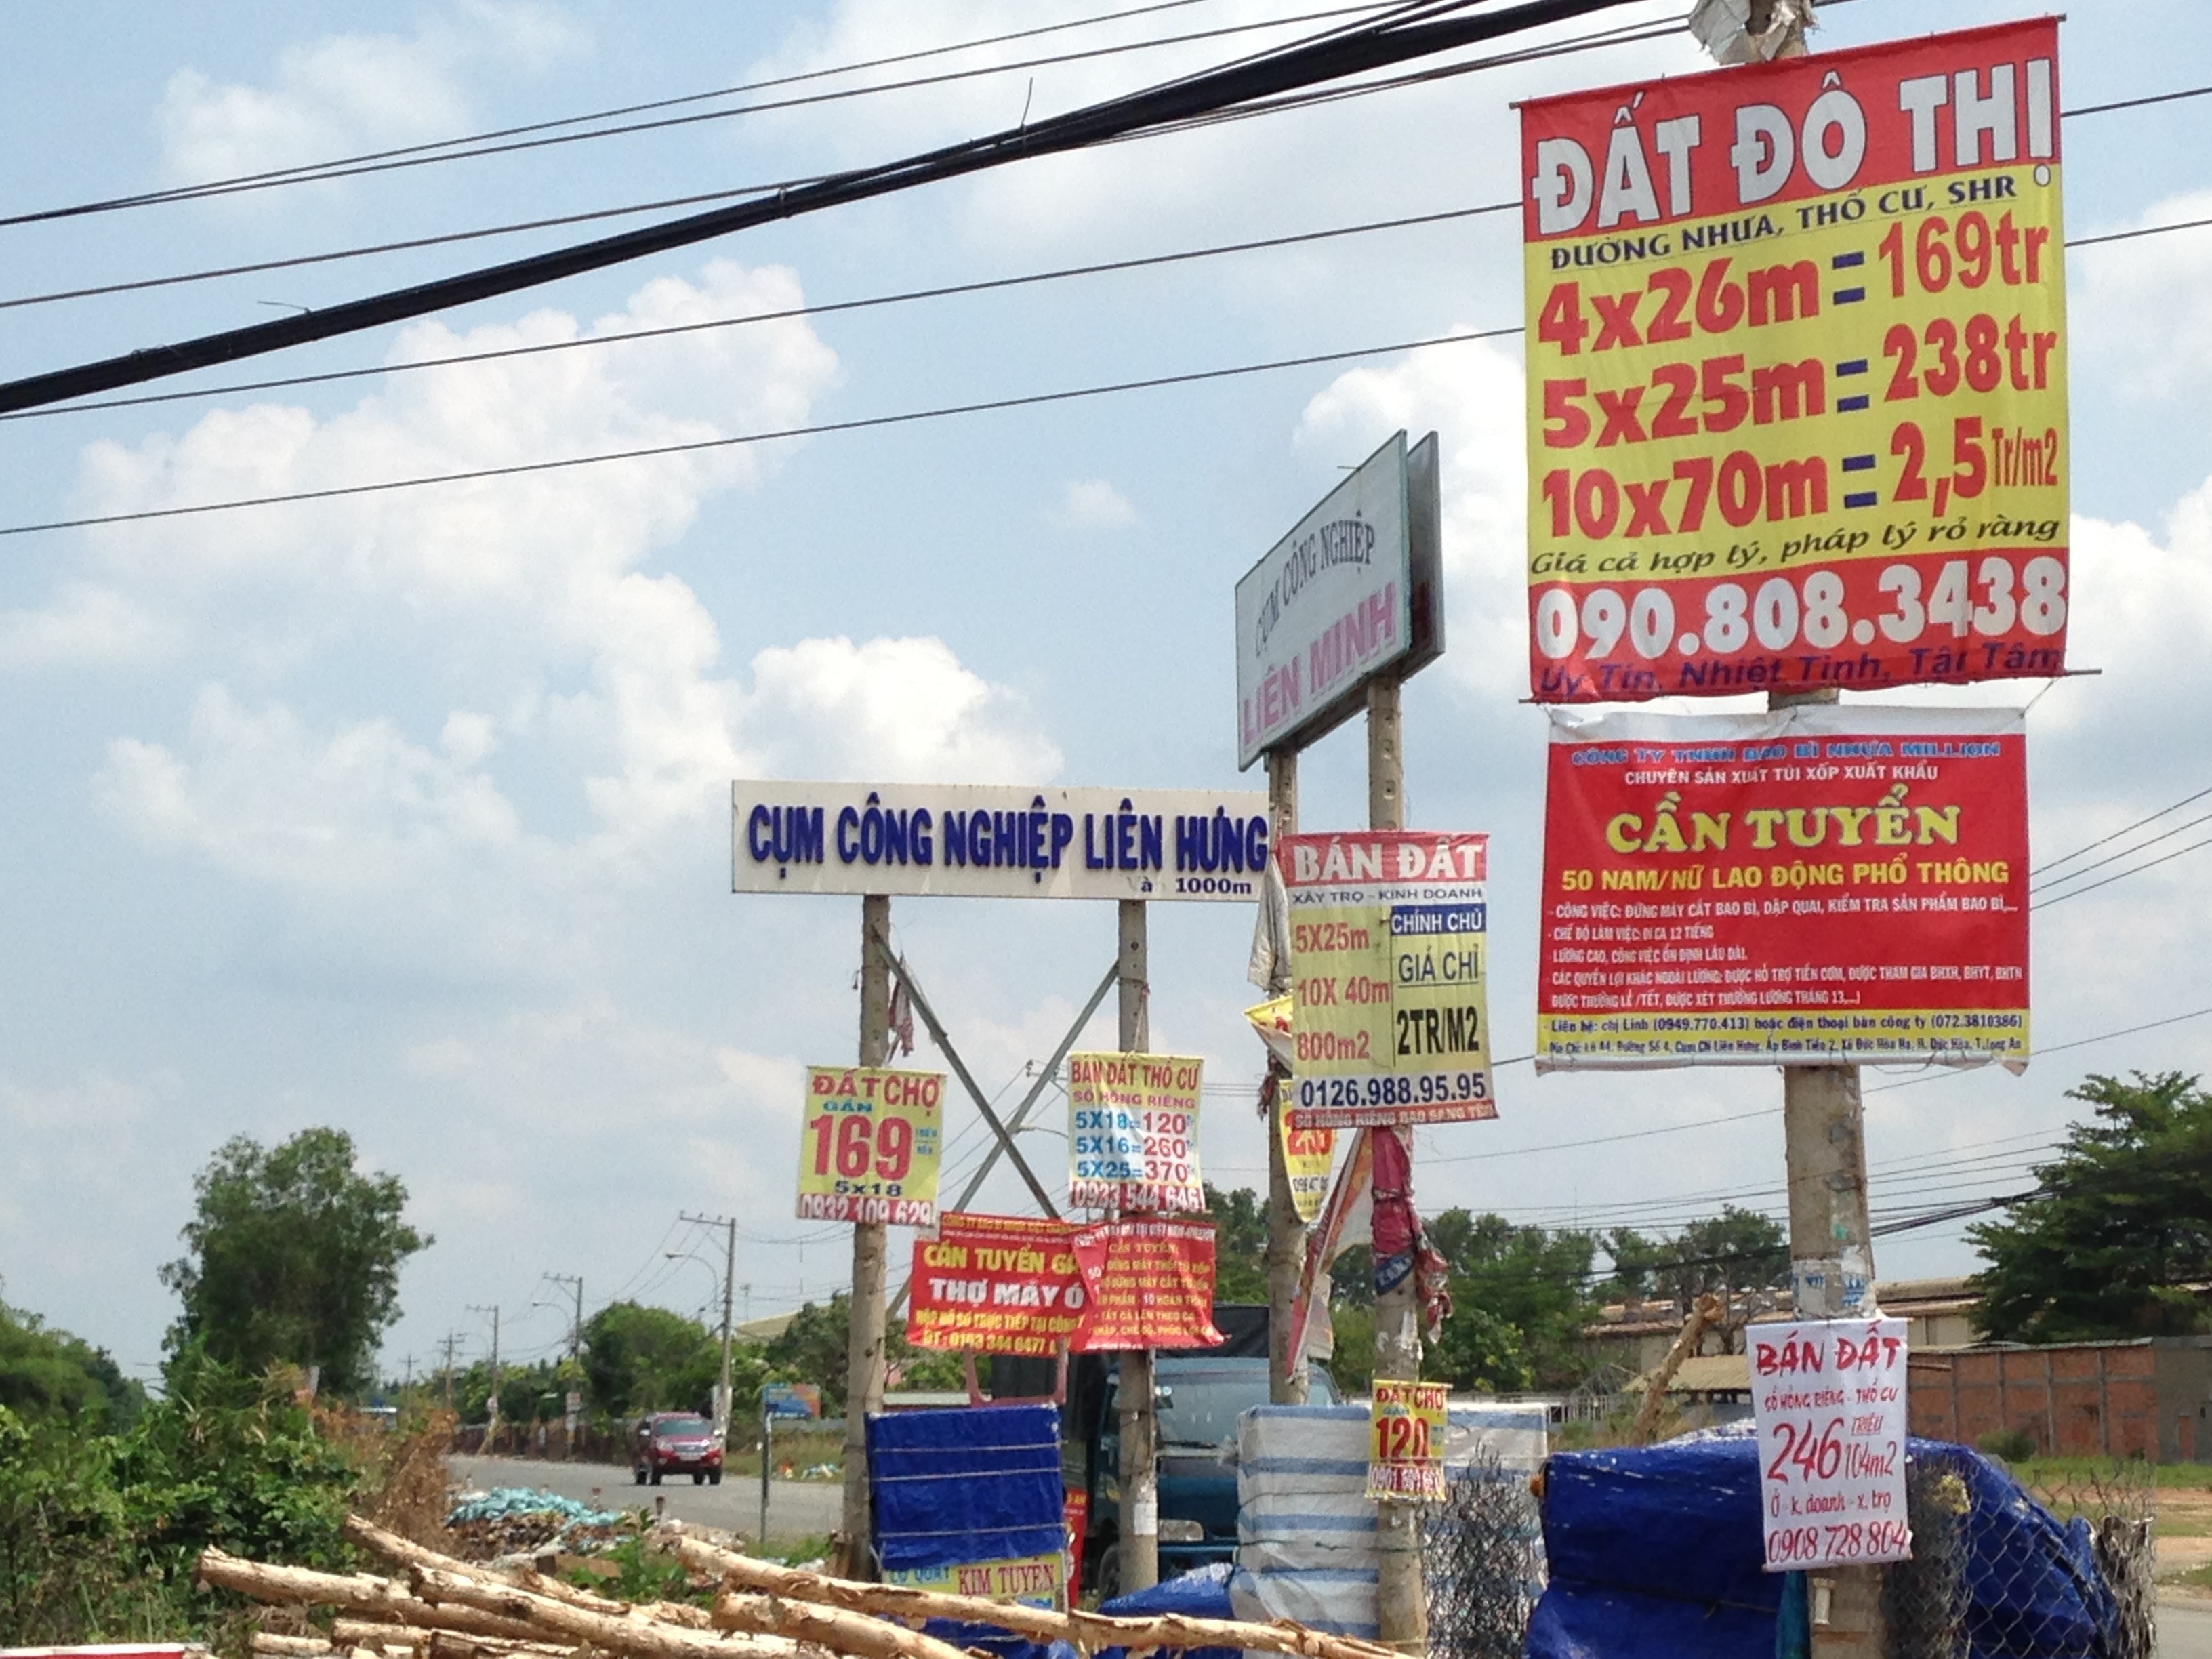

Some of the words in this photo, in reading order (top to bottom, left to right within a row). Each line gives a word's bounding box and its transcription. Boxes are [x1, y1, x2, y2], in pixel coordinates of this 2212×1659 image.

[1532, 93, 1701, 234] ĐẤT
[1731, 70, 1866, 203] ĐÔ
[1900, 58, 2052, 187] THỊ
[1551, 234, 1671, 270] ĐƯỜNG
[1948, 176, 2017, 205] SHR
[1538, 258, 1820, 356] 4x26m
[1879, 208, 2049, 298] 169tr
[1543, 354, 1825, 448] 5x25m
[1883, 313, 2057, 402] 238tr
[1542, 450, 1828, 540] 10x70m
[1890, 416, 1987, 518] 2,5
[1991, 426, 2058, 487] Tr/m2
[1320, 509, 1376, 576] NGHIỆP
[1531, 552, 1588, 575] Giá
[1598, 551, 1639, 572] cả
[1649, 550, 1716, 573] hợp
[1780, 527, 1869, 562] pháp
[1881, 521, 1917, 550] lý
[1976, 514, 2060, 541] ràng
[1536, 556, 2068, 660] 090.808.3438
[1242, 654, 1303, 745] LIÊN
[1309, 580, 1396, 695] MINH
[1679, 657, 1783, 692] Nhiệt
[1625, 767, 1689, 785] CHUYÊN
[1694, 766, 1727, 784] SẢN
[1774, 764, 1801, 781] TÚI
[1806, 762, 1839, 780] XỐP
[1844, 761, 1887, 779] XUẤT
[1892, 759, 1938, 780] KHẨU
[1634, 747, 1666, 764] TY
[749, 804, 824, 880] CỤM
[838, 792, 933, 867] CÔNG
[944, 794, 1073, 883] NGHIỆP
[1085, 798, 1163, 871] LIÊN
[1605, 790, 1732, 854] CẦN
[1744, 782, 1961, 849] TUYỂN
[1294, 836, 1383, 882] BÁN
[1397, 836, 1484, 879] ĐẤT
[1561, 870, 1593, 891] 50
[1601, 863, 1704, 892] NAM/NỮ
[1712, 867, 1763, 889] LAO
[1770, 860, 1844, 890] ĐỘNG
[1853, 851, 1908, 884] PHỔ
[1916, 857, 2010, 884] THÔNG
[1176, 878, 1252, 895] 1000m
[1293, 889, 1324, 905] XÂY
[1330, 890, 1364, 904] TRỌ
[1379, 886, 1418, 901] KINH
[1424, 888, 1483, 899] DOANH
[1865, 898, 1889, 912] TRA
[1296, 922, 1370, 954] 5X25m
[1392, 909, 1443, 933] CHÍNH
[1447, 909, 1483, 932] CHỦ
[1399, 945, 1436, 983] GIÁ
[1443, 943, 1479, 981] CHỈ
[1298, 977, 1337, 1007] 10X
[1345, 976, 1389, 1004] 40m
[1298, 1030, 1370, 1061] 800m2
[1397, 1006, 1480, 1055] 2TR/M2
[813, 1068, 881, 1098] ĐẤT
[884, 1074, 940, 1117] CHỢ
[1148, 1092, 1195, 1109] RIÊNG
[1300, 1073, 1487, 1107] 0126.988.95.95
[1143, 1112, 1186, 1135] 120
[810, 1113, 912, 1181] 169
[1143, 1136, 1187, 1159] 260
[835, 1181, 902, 1197] 5x18
[1145, 1160, 1188, 1183] 370
[923, 1239, 968, 1269] CẦN
[975, 1243, 1046, 1273] TUYỂN
[929, 1278, 988, 1308] THỢ
[1756, 1330, 1825, 1377] BÁN
[1835, 1320, 1900, 1372] ĐẤT
[1767, 1417, 1845, 1484] 246
[1845, 1441, 1897, 1481] 104m2
[1806, 1492, 1846, 1514] doanh
[1769, 1526, 1818, 1564] 0908
[1825, 1523, 1863, 1561] 728
[1866, 1520, 1906, 1556] 804
